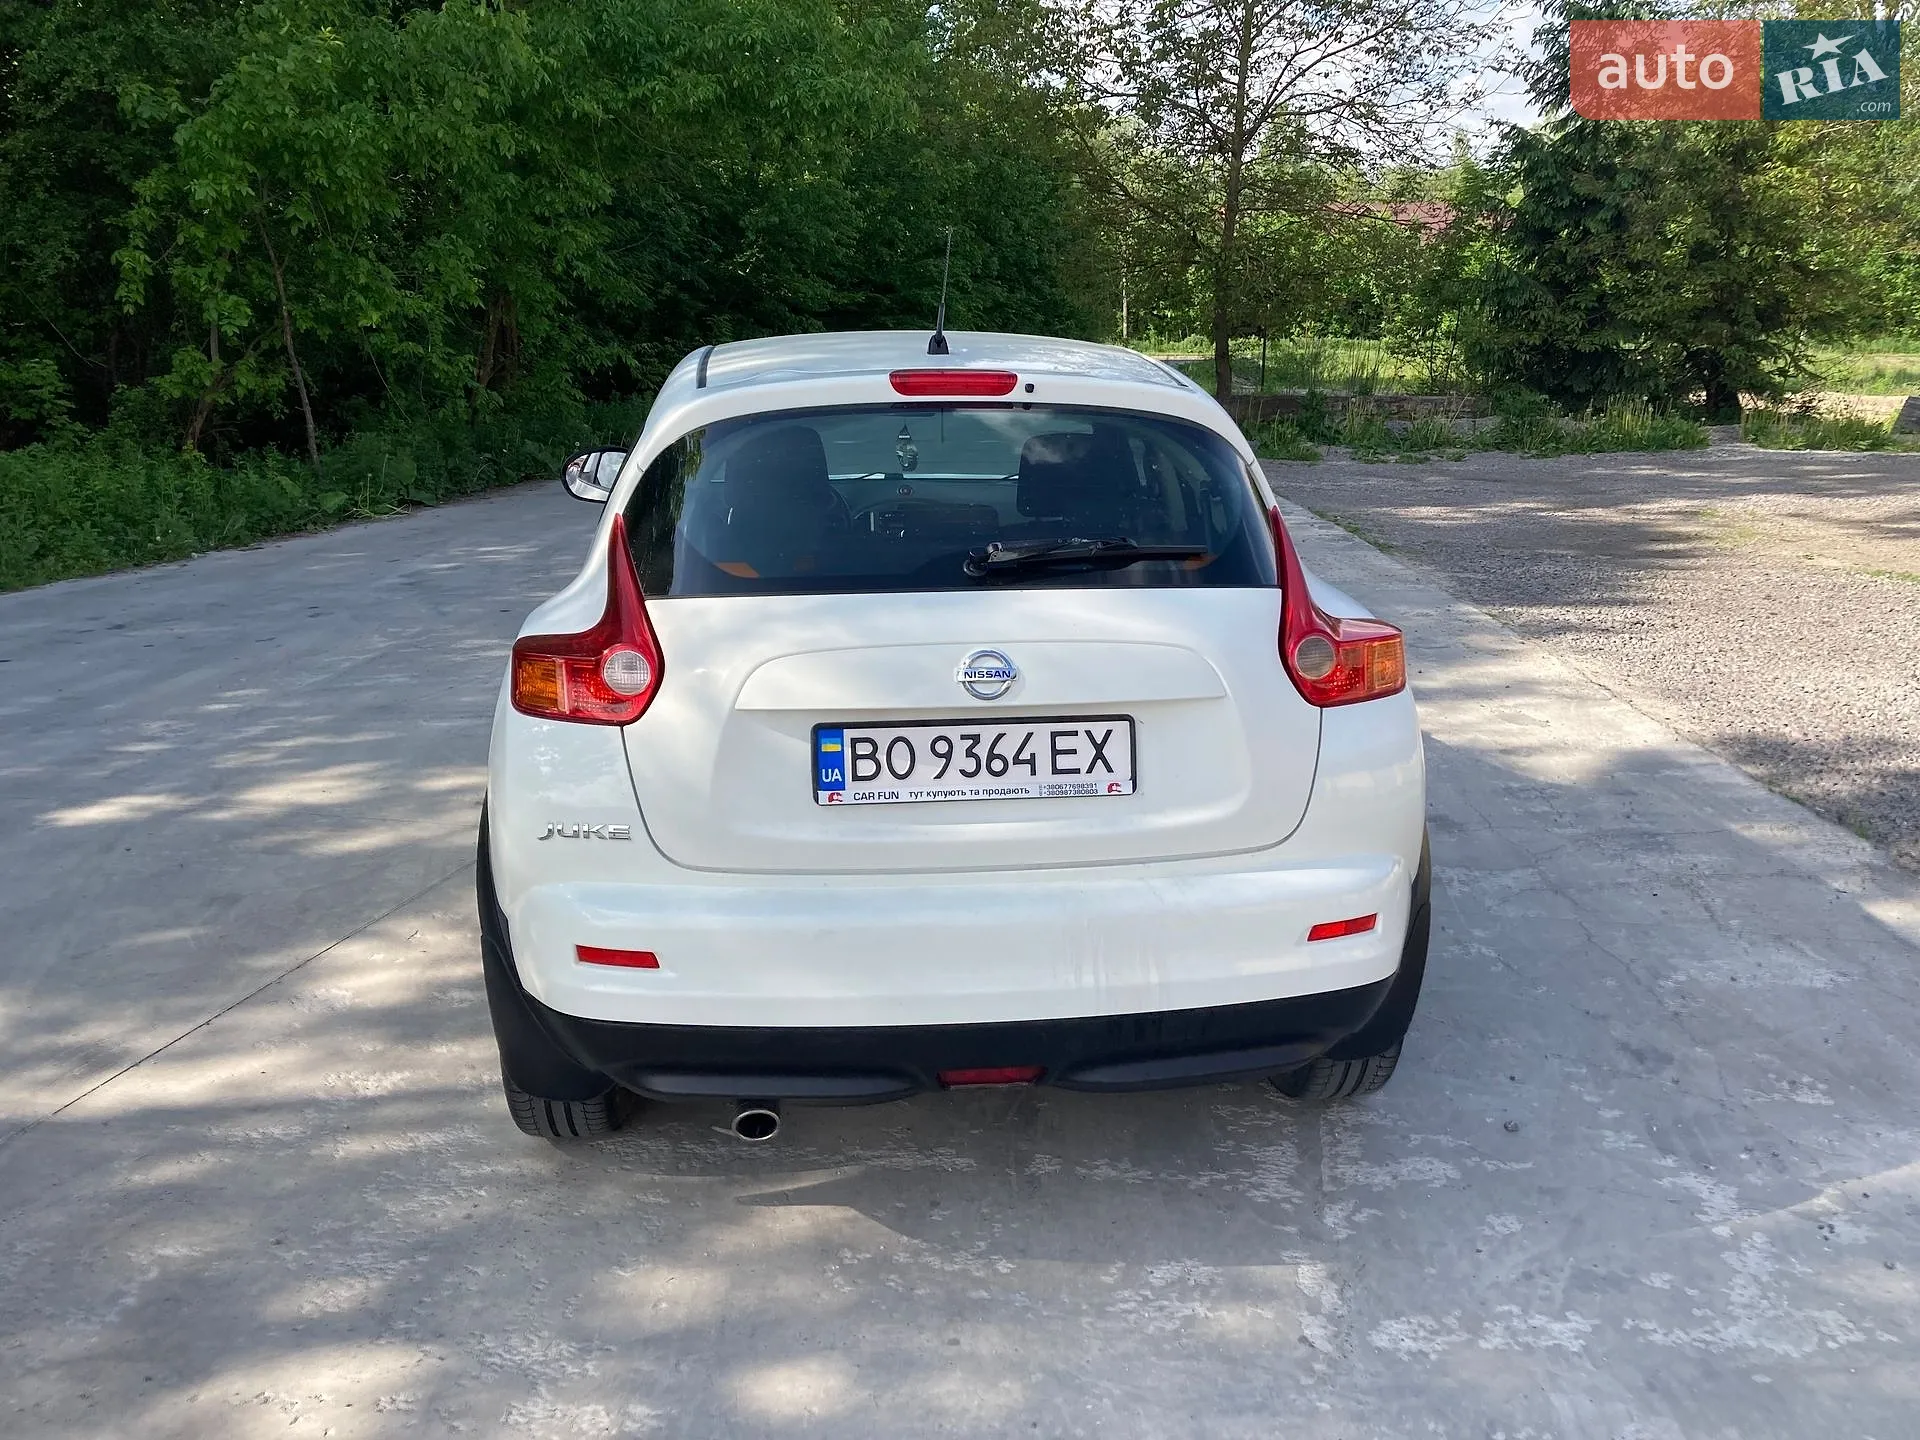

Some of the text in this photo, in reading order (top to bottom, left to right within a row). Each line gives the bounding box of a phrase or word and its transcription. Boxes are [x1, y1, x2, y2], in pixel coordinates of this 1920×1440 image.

[964, 670, 1011, 679] NISSAN
[849, 728, 1114, 782] BO 9364 EX
[822, 768, 842, 783] UA
[853, 791, 900, 801] CAR FUN
[908, 787, 1030, 800] тут купують та продають
[537, 823, 632, 841] JUKE
